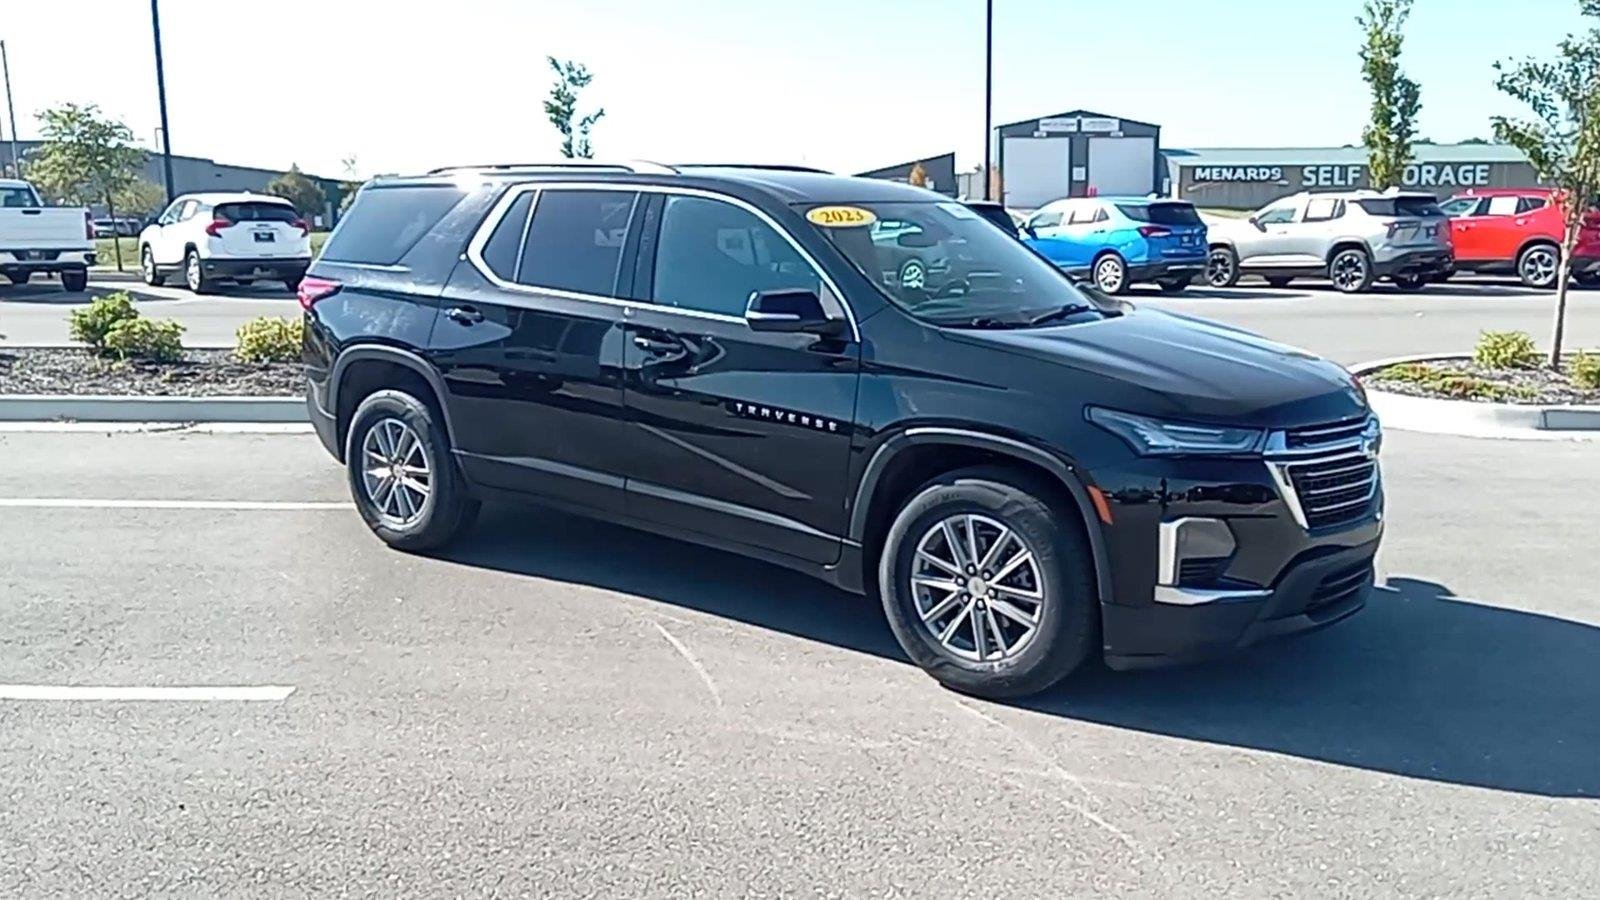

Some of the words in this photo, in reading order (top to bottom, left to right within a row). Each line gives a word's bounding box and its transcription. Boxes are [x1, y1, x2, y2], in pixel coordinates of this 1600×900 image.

[1194, 166, 1283, 181] MENARDS
[1302, 166, 1362, 187] SELF
[1374, 164, 1490, 186] ORAGE
[819, 209, 865, 224] 2023
[735, 402, 838, 432] TRAVERSE
